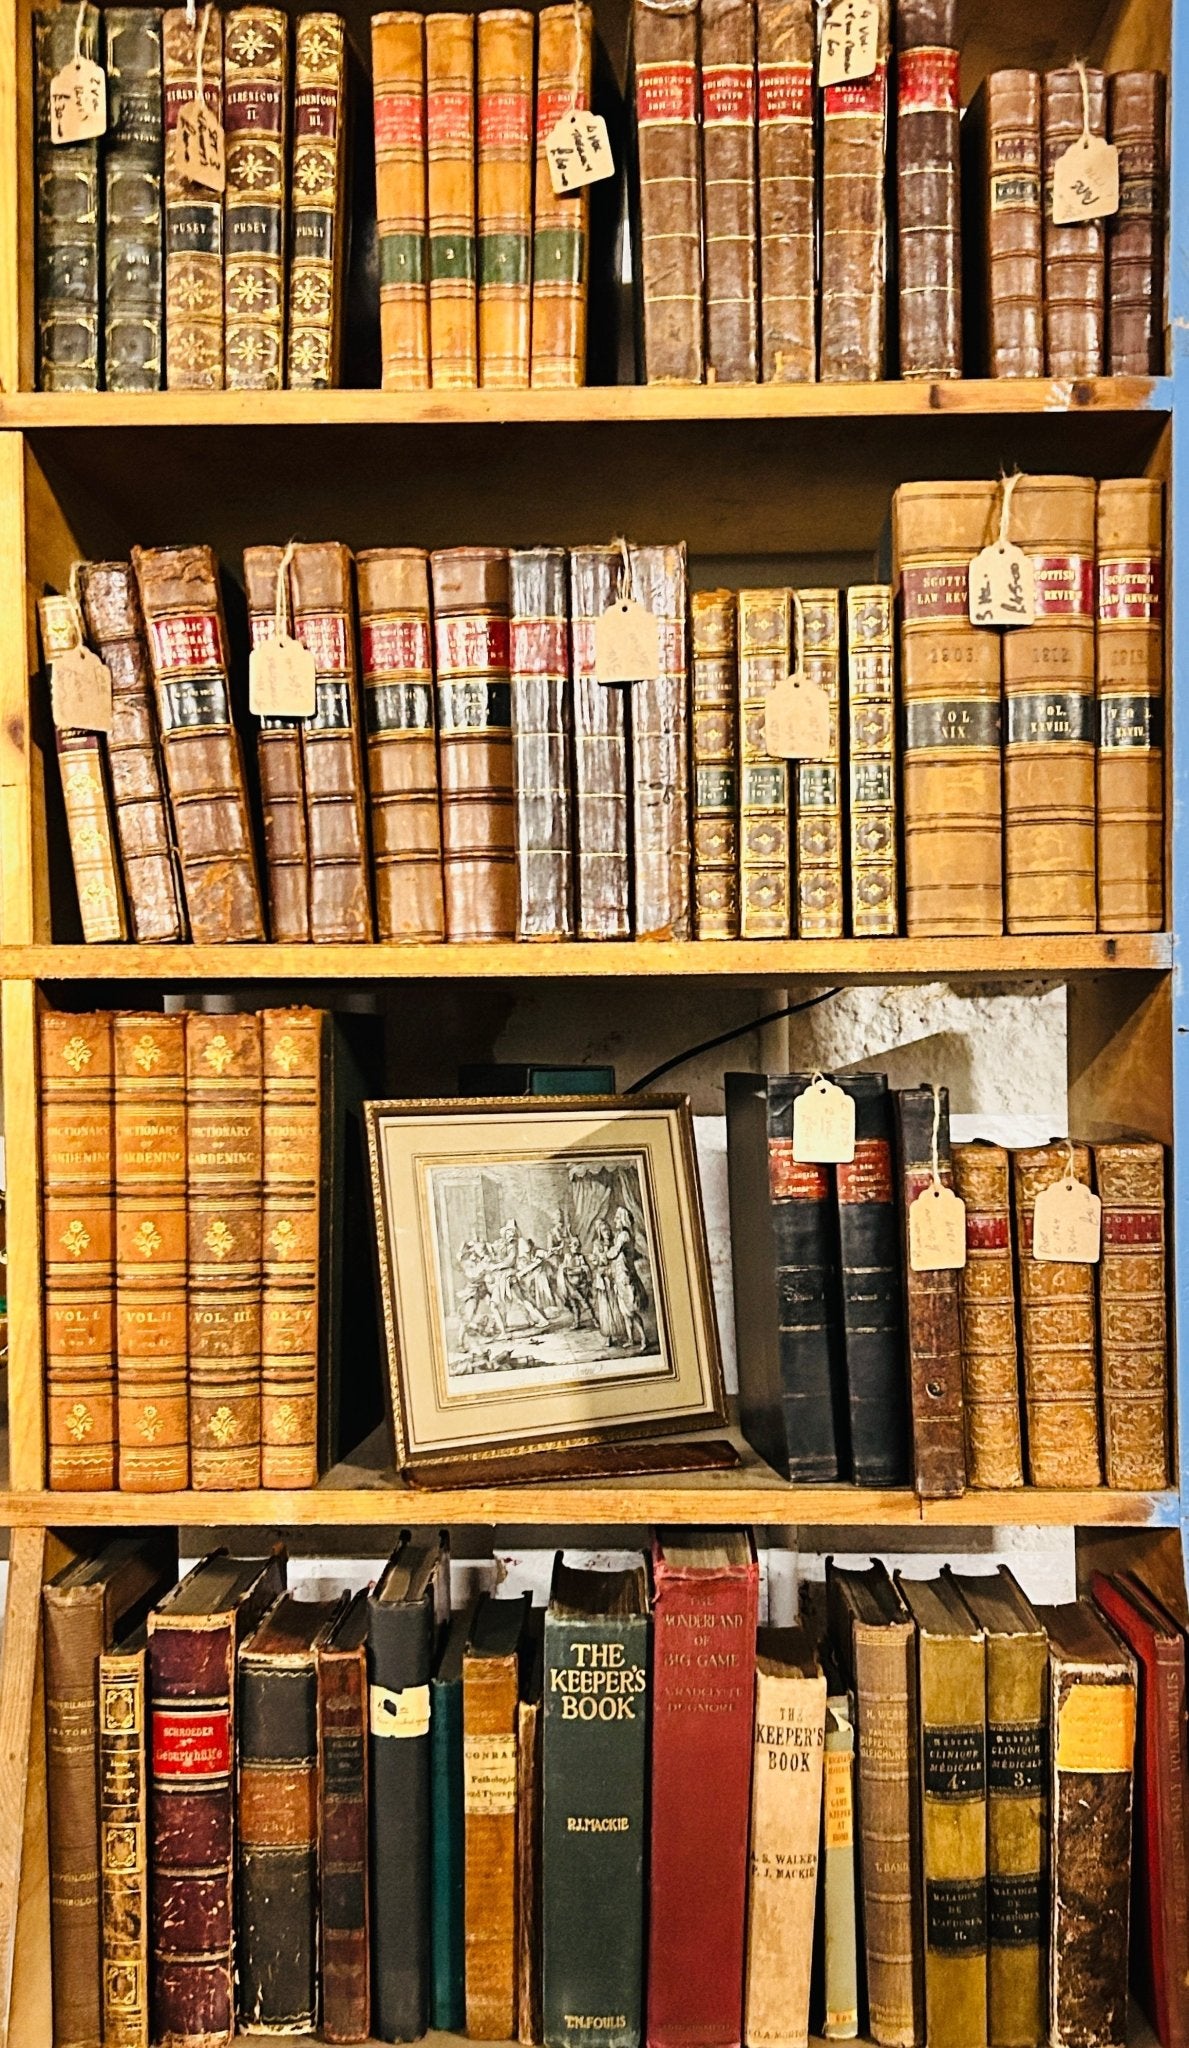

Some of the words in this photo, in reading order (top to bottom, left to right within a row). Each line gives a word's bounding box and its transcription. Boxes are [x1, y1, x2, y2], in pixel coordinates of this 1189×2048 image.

[167, 89, 217, 101] EIRENION
[767, 89, 804, 98] REVIEW
[173, 224, 206, 234] PUSEY
[234, 223, 267, 234] PUSEY
[296, 227, 324, 238] PUSEY
[923, 576, 967, 588] SCOTTI
[1105, 574, 1154, 586] SCOTTISH
[917, 593, 938, 605] LAW
[945, 593, 967, 605] REV
[1044, 590, 1082, 601] REVIEW
[1039, 705, 1067, 717] VOL.
[192, 1127, 251, 1137] DICTIONARY
[265, 1127, 319, 1136] CTIONARY
[1105, 1215, 1160, 1223] POPE'
[1106, 1233, 1160, 1241] WORK
[976, 1271, 991, 1287] 4
[1052, 1270, 1065, 1287] 6
[56, 1311, 89, 1322] VOL.
[126, 1312, 159, 1322] VOL.
[195, 1312, 229, 1323] VOL.
[271, 1311, 292, 1320] OL.
[690, 1597, 715, 1606] THE
[665, 1614, 743, 1628] WONDERLAND
[694, 1635, 711, 1646] OF
[570, 1643, 625, 1668] THE
[665, 1653, 691, 1667] BIG
[697, 1653, 740, 1667] GAME
[550, 1665, 646, 1693] KEEPER'S
[1166, 1672, 1180, 1712] MAPS
[562, 1695, 636, 1720] BOOK
[780, 1708, 803, 1721] THE
[878, 1710, 907, 1720] WEBE
[164, 1727, 214, 1737] SCHROEDER
[756, 1723, 824, 1747] KEEPER'S
[929, 1750, 979, 1760] CLINIQUE
[991, 1745, 1040, 1756] CLINIQUE
[768, 1750, 810, 1772] BOOK
[992, 1759, 1042, 1769] MÉDICALE
[929, 1762, 982, 1772] MÉDICALE
[482, 1789, 516, 1798] Therap
[776, 1867, 815, 1880] MACKIE
